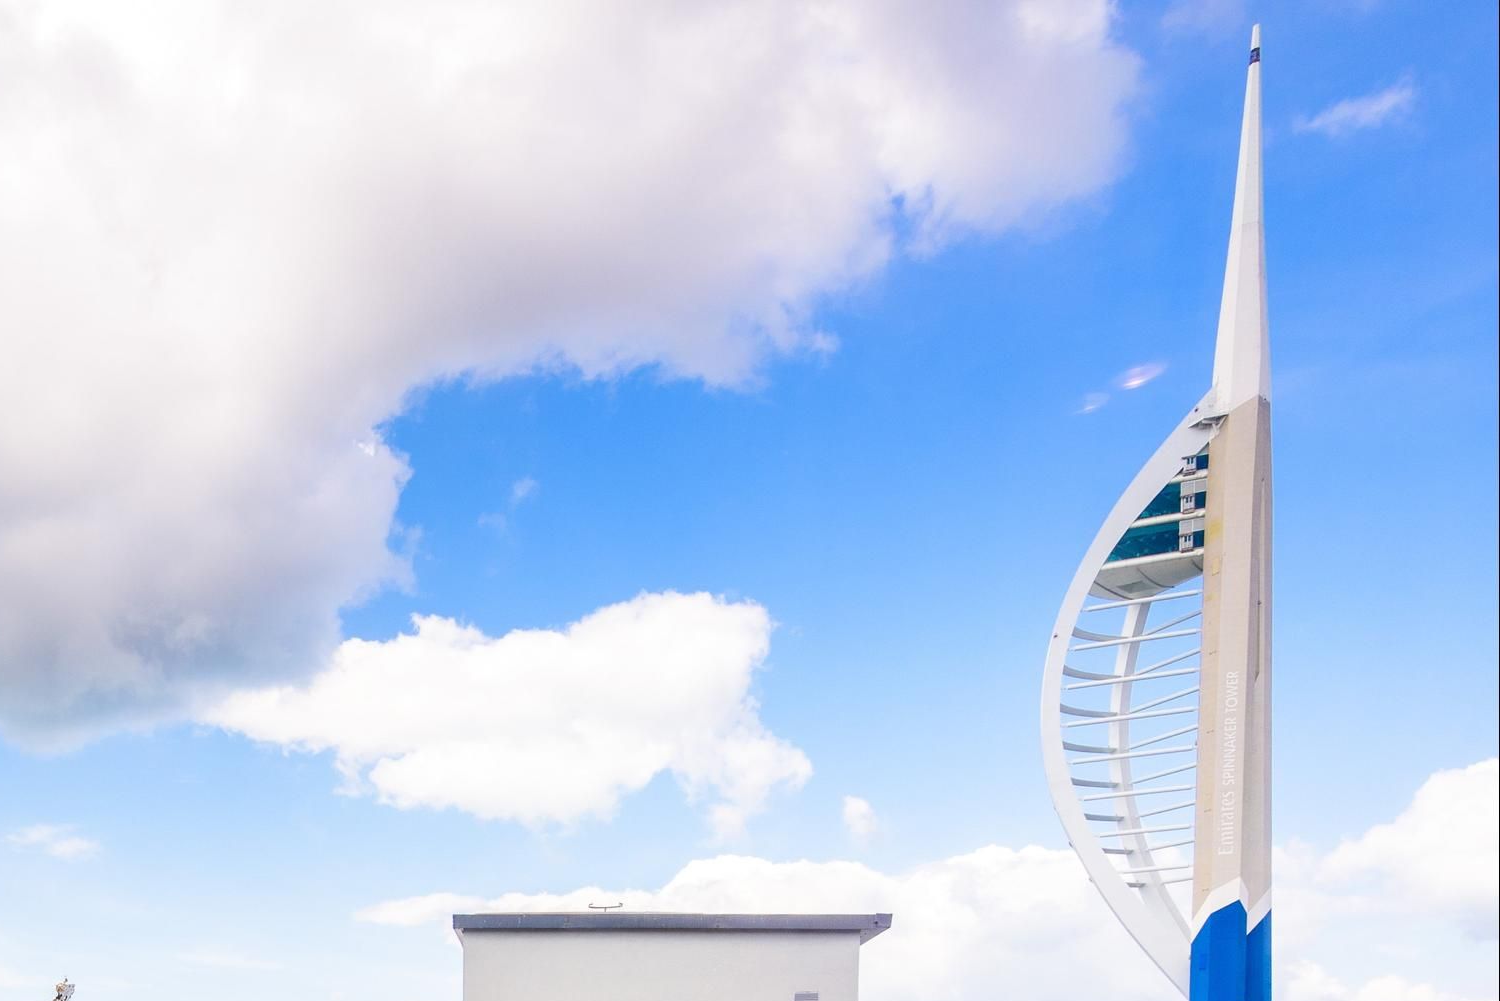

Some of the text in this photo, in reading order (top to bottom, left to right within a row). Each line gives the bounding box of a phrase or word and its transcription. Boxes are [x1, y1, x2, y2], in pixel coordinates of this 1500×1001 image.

[1218, 671, 1239, 856] Emirates SPINNAKER TOWER
